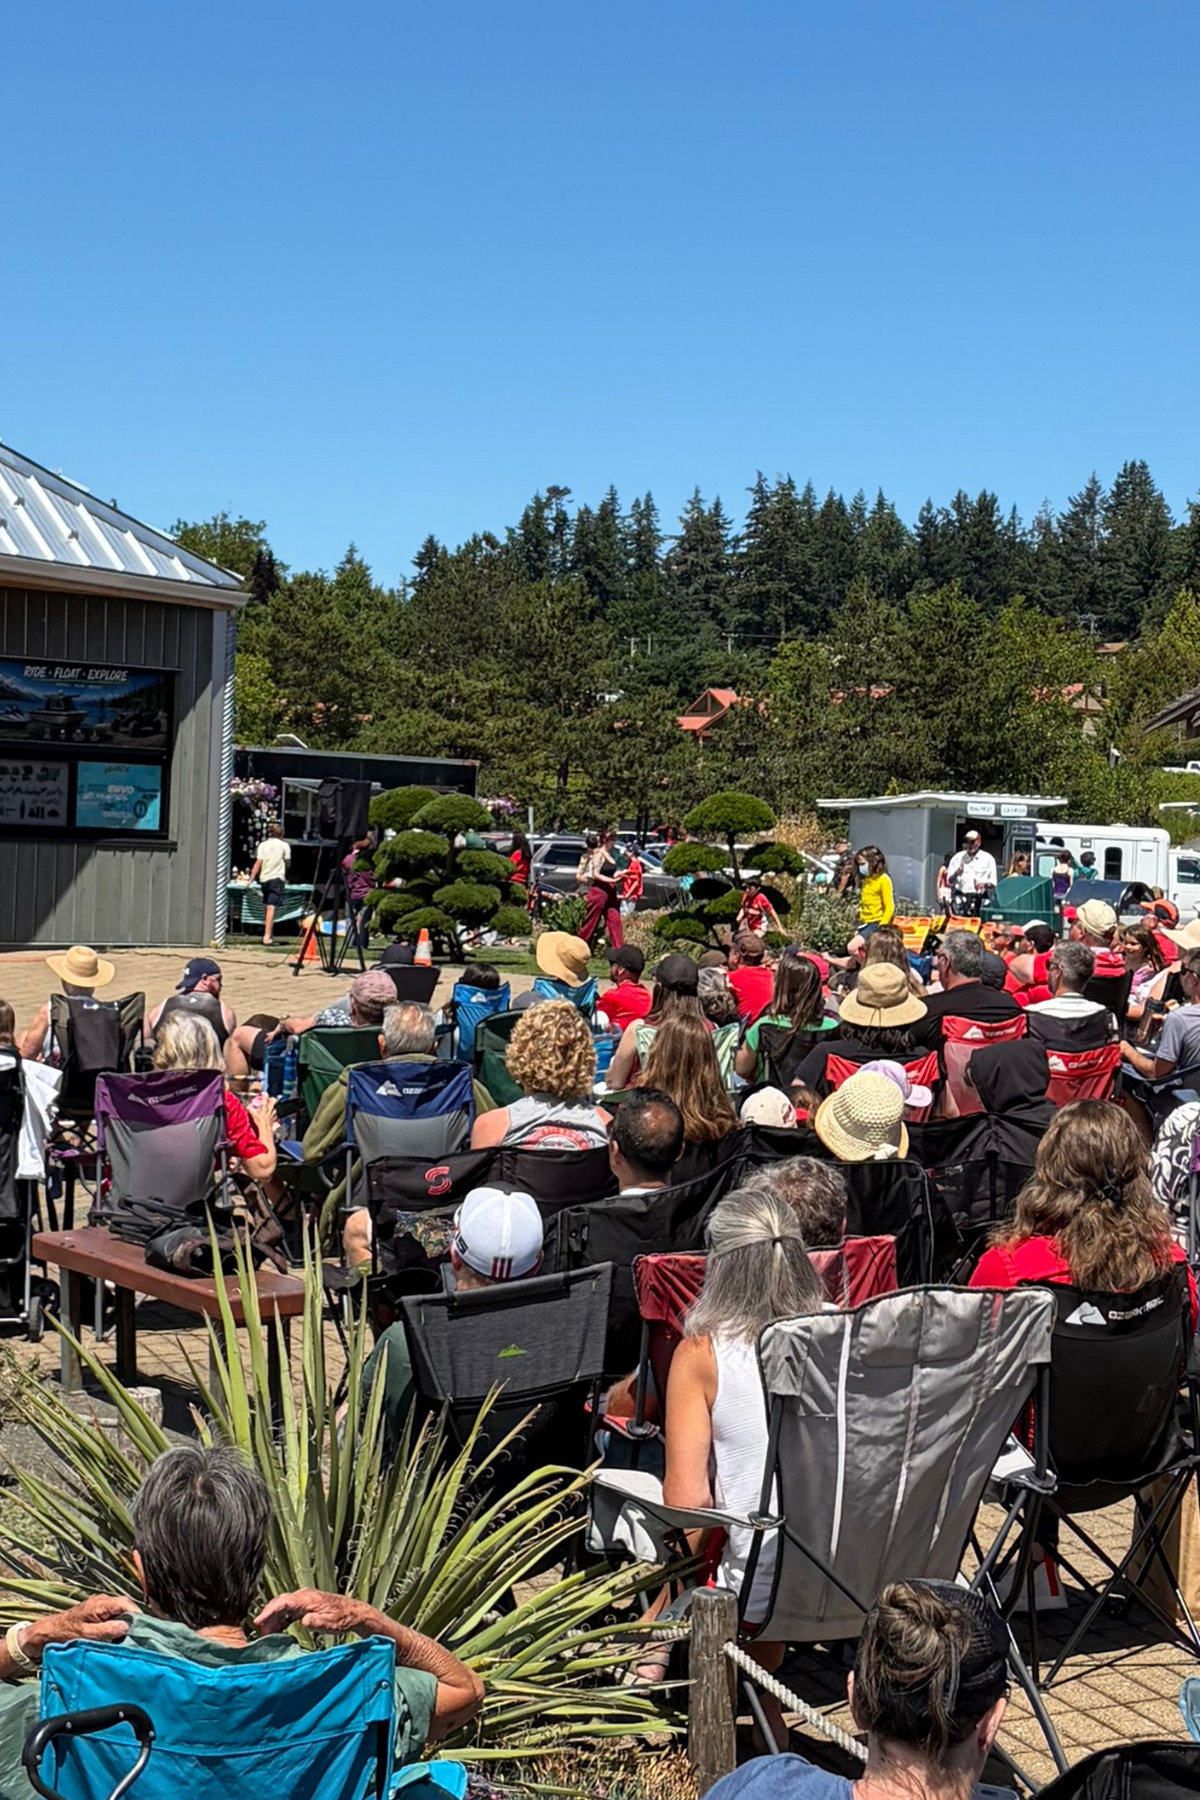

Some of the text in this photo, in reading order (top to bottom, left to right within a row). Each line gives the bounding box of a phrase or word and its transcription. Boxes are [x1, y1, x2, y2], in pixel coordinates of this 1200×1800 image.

[23, 665, 129, 682] RIDE FLOAT EXPLORE
